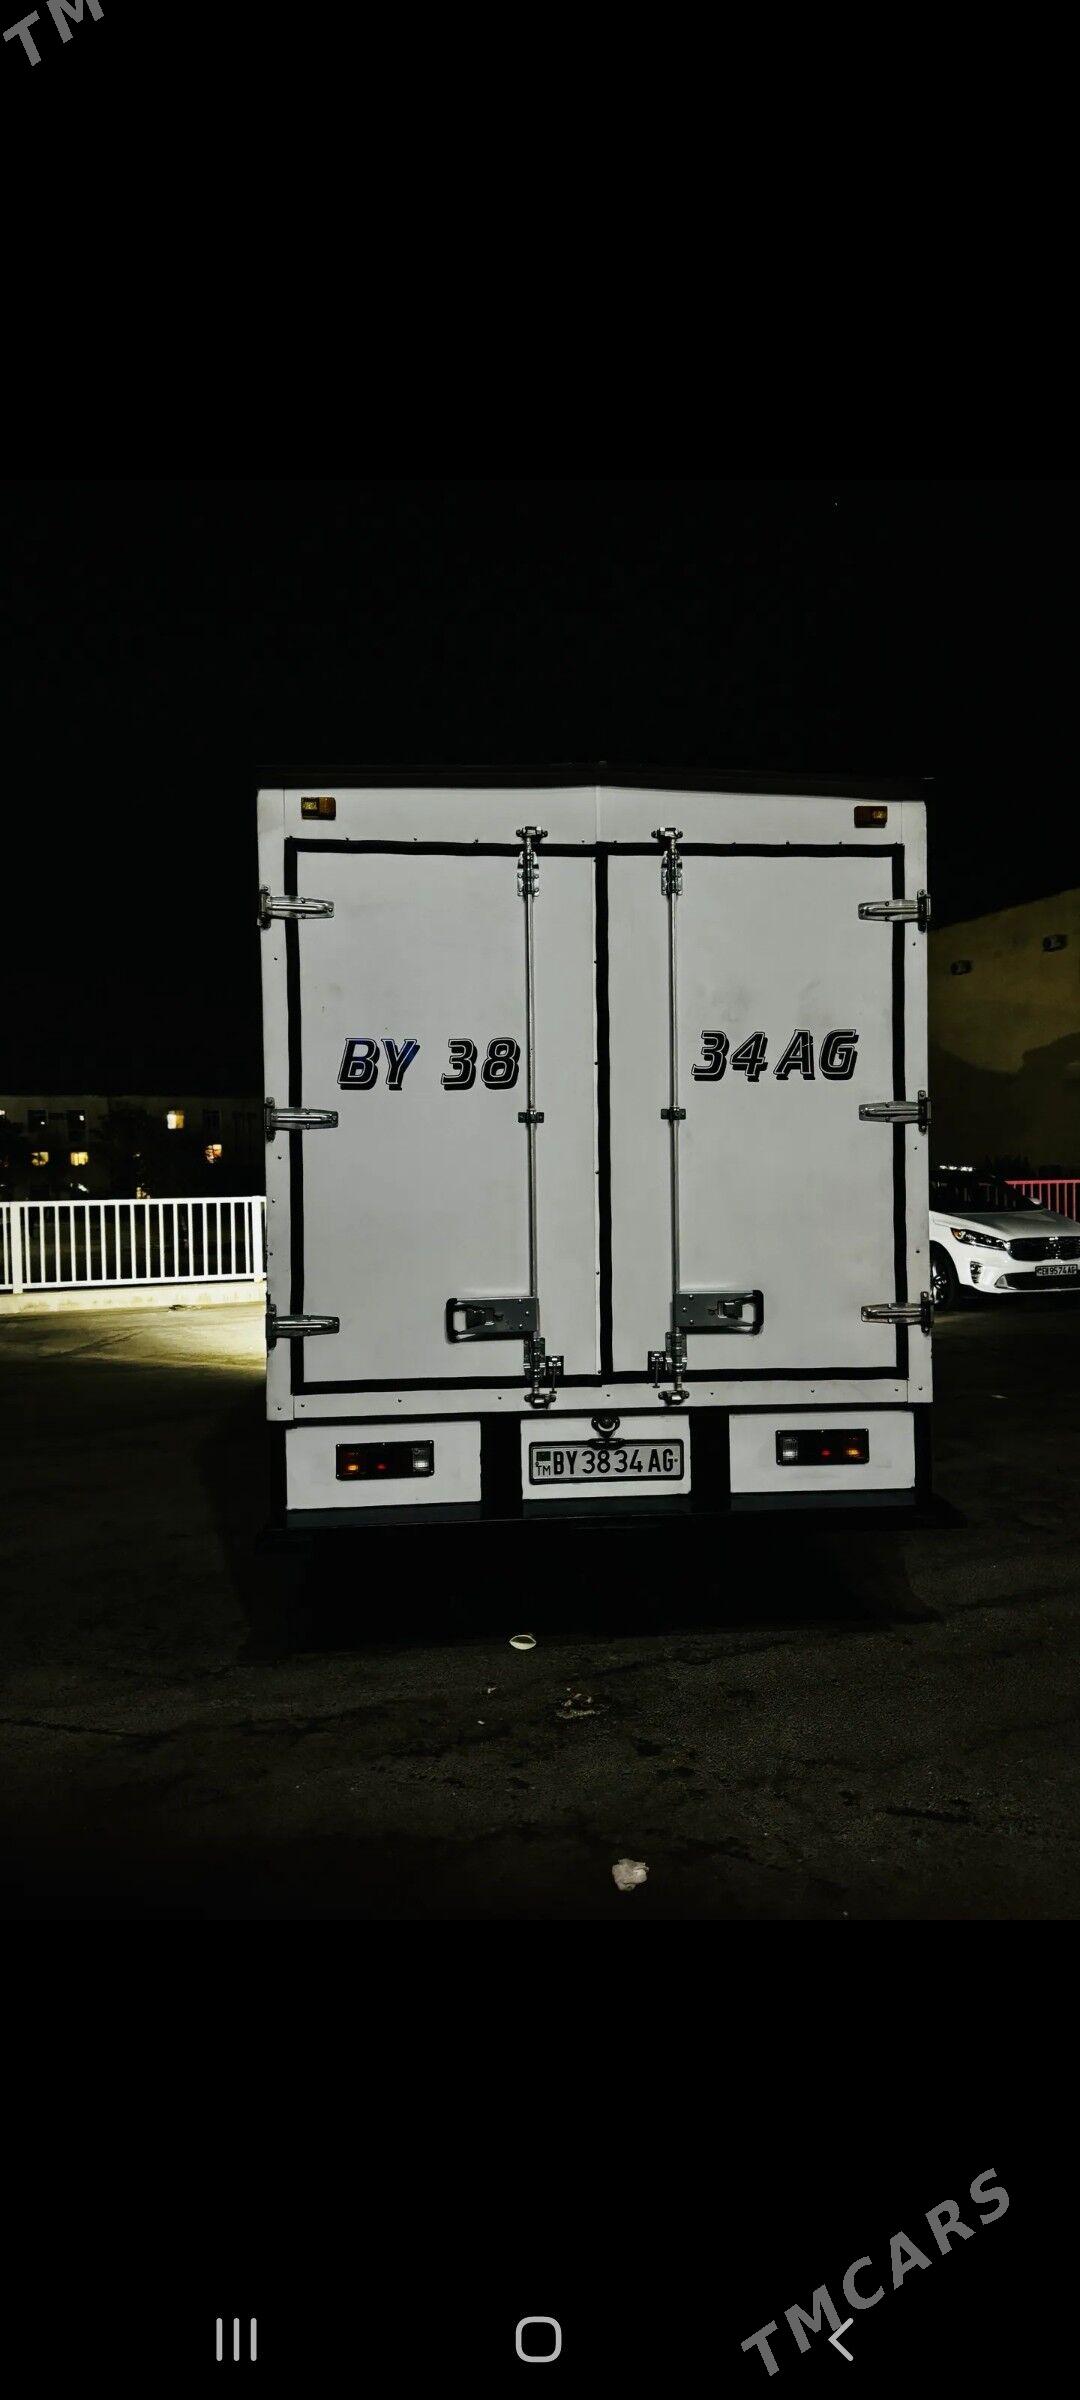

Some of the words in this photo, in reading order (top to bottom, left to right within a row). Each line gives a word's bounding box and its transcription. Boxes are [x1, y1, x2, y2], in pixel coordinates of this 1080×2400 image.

[337, 1037, 421, 1091] BY
[440, 1037, 520, 1091] 38
[537, 1466, 551, 1476] TM
[553, 1450, 577, 1475] BY
[648, 1448, 674, 1473] AG
